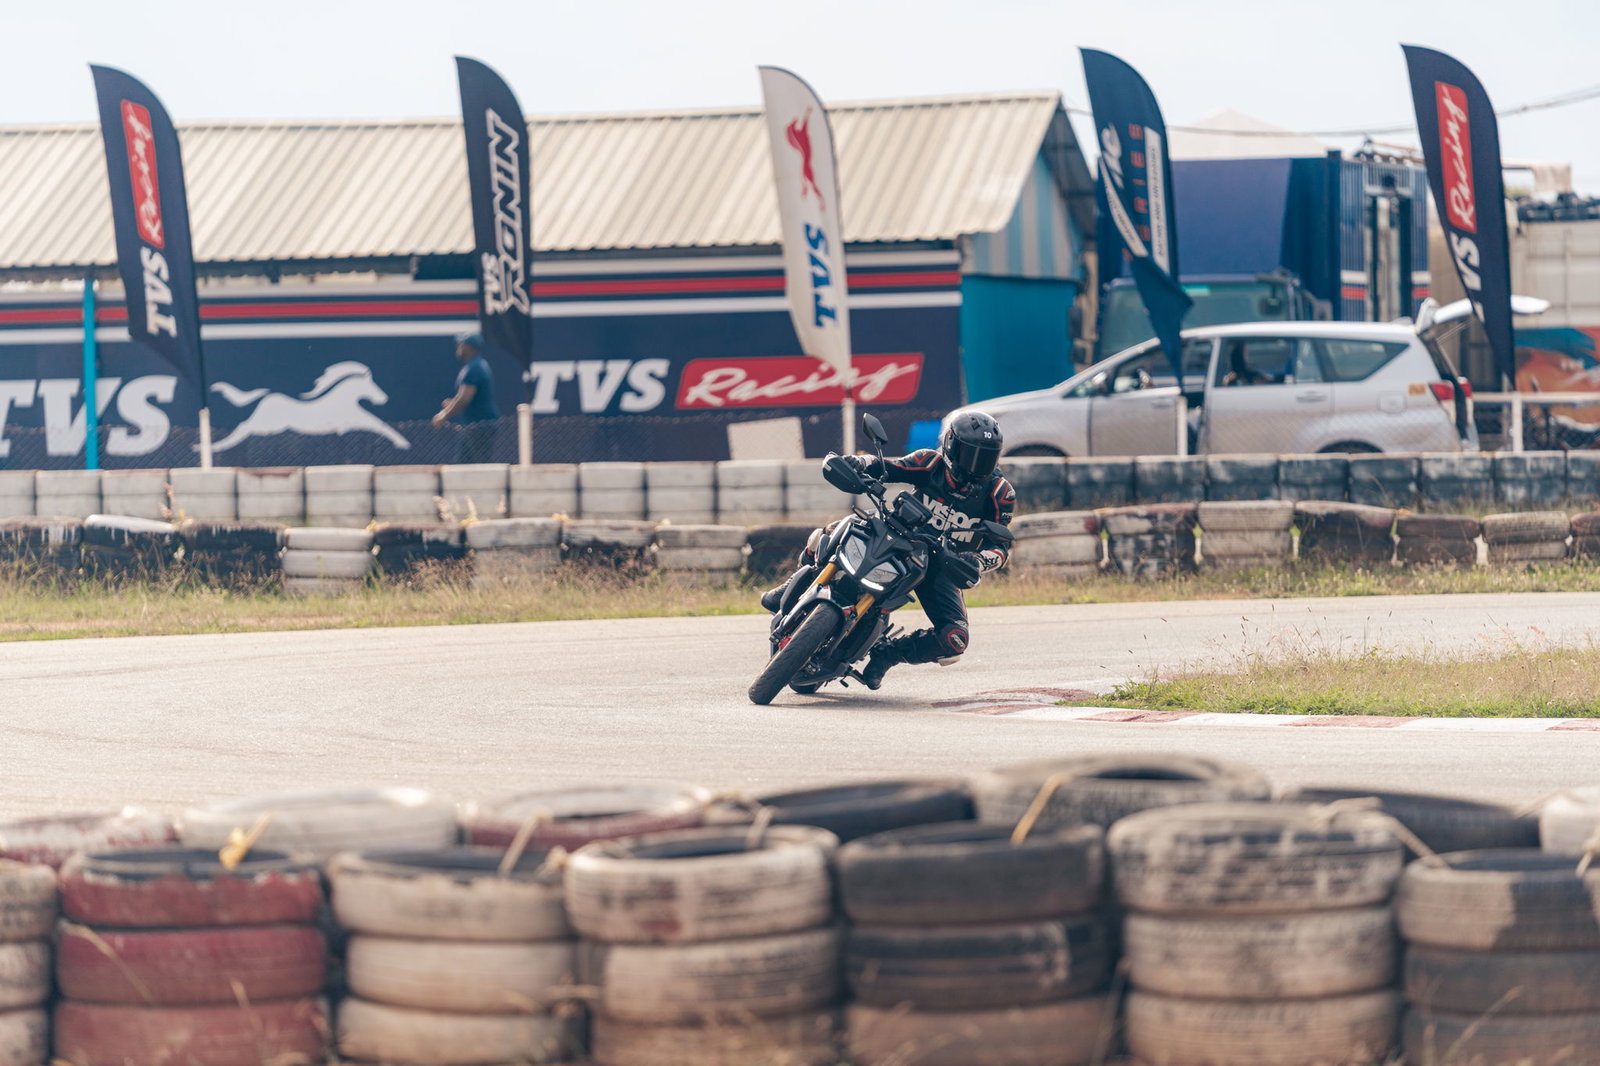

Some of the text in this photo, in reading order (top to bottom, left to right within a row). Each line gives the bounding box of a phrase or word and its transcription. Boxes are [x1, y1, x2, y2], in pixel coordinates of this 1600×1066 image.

[1440, 83, 1474, 228] Racing
[485, 107, 530, 315] RONIN
[140, 246, 178, 339] TVS
[804, 223, 837, 328] TVS
[522, 358, 671, 414] TVS
